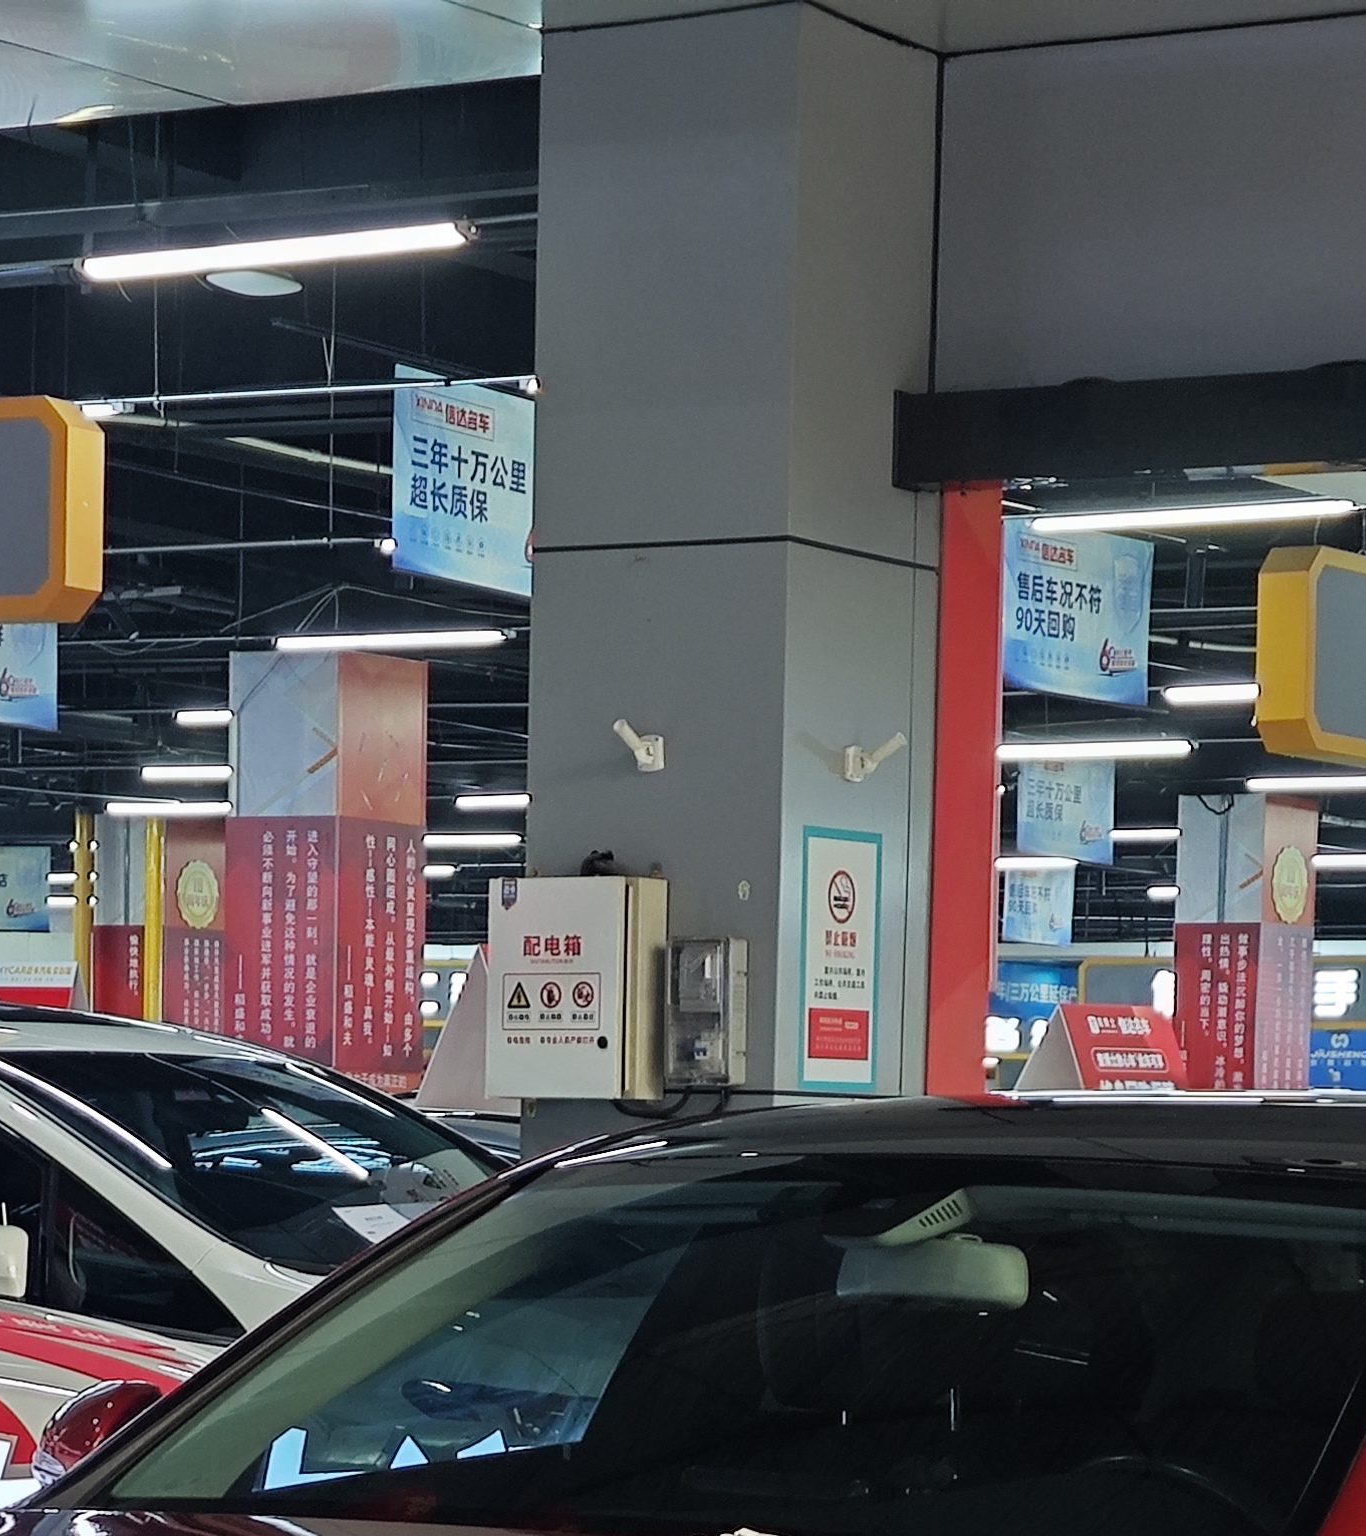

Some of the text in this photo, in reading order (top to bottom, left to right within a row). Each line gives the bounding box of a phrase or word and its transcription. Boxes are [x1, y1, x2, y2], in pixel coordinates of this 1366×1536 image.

[445, 404, 490, 433] 信达名车
[412, 435, 526, 494] 三年十万公里
[410, 473, 488, 523] 超长质保
[1017, 571, 1101, 614] 售后车况不符
[1016, 606, 1075, 642] 90天回购
[1027, 778, 1082, 804] 三年十万公里
[523, 935, 582, 957] 配电箱
